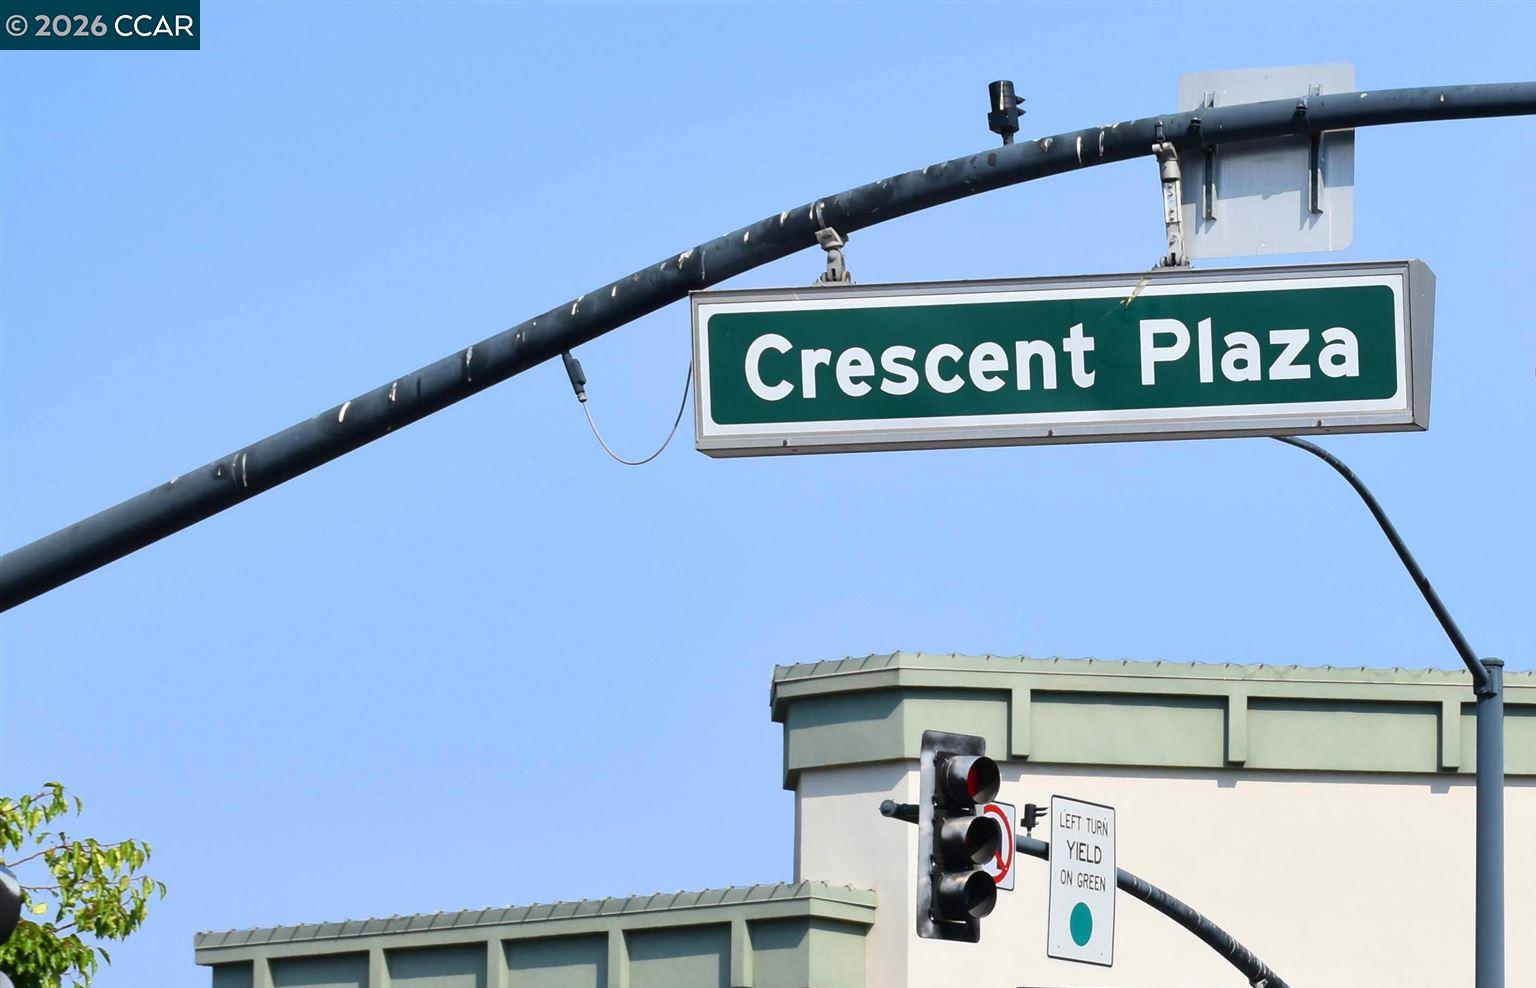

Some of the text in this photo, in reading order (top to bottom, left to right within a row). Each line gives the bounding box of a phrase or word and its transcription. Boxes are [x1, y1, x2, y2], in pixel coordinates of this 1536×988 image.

[744, 316, 1360, 402] Crescent Plaza
[1059, 811, 1109, 837] LEFT TURN
[1066, 839, 1102, 865] YIELD
[1060, 868, 1106, 892] ON GREEN
